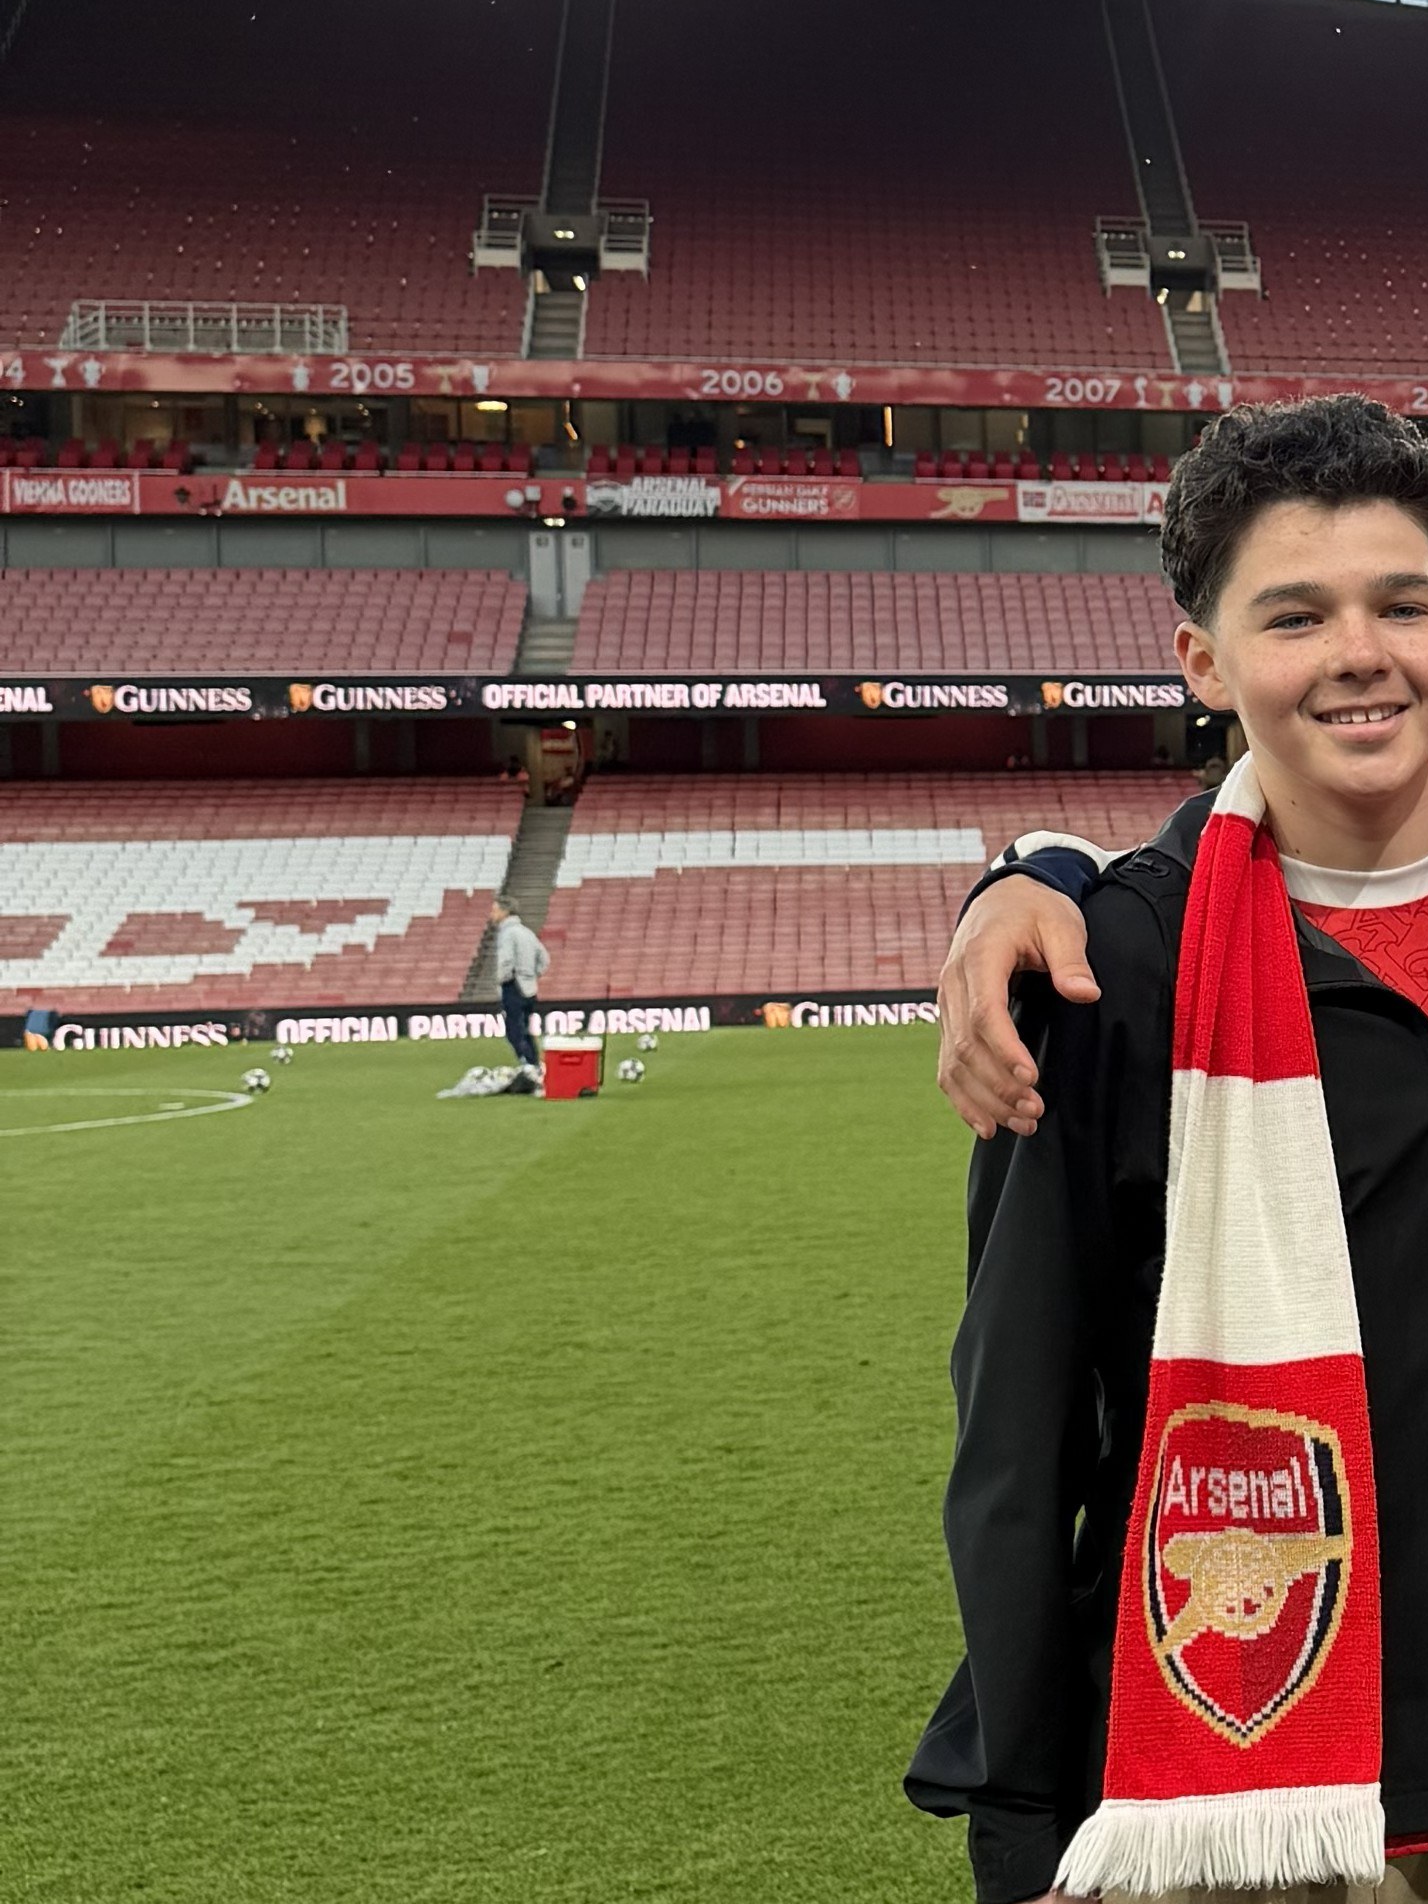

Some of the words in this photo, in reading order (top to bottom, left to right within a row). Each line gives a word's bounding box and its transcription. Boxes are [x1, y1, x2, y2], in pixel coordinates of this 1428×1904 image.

[330, 362, 416, 390] 2005
[701, 369, 785, 396] 2006
[1044, 378, 1121, 403] 2007
[220, 479, 347, 511] Arsenal
[114, 684, 253, 713] GUINNESS
[312, 683, 448, 711] GUINNESS
[482, 683, 584, 709] OFFICIAL
[585, 683, 691, 709] PARTNER
[692, 683, 723, 708] OF
[723, 683, 827, 708] ARSENAL
[881, 681, 1009, 709] GUINNESS
[1062, 681, 1186, 708] GUINNESS
[791, 1000, 940, 1028] GUINNES
[1162, 1454, 1309, 1521] Arsenal
